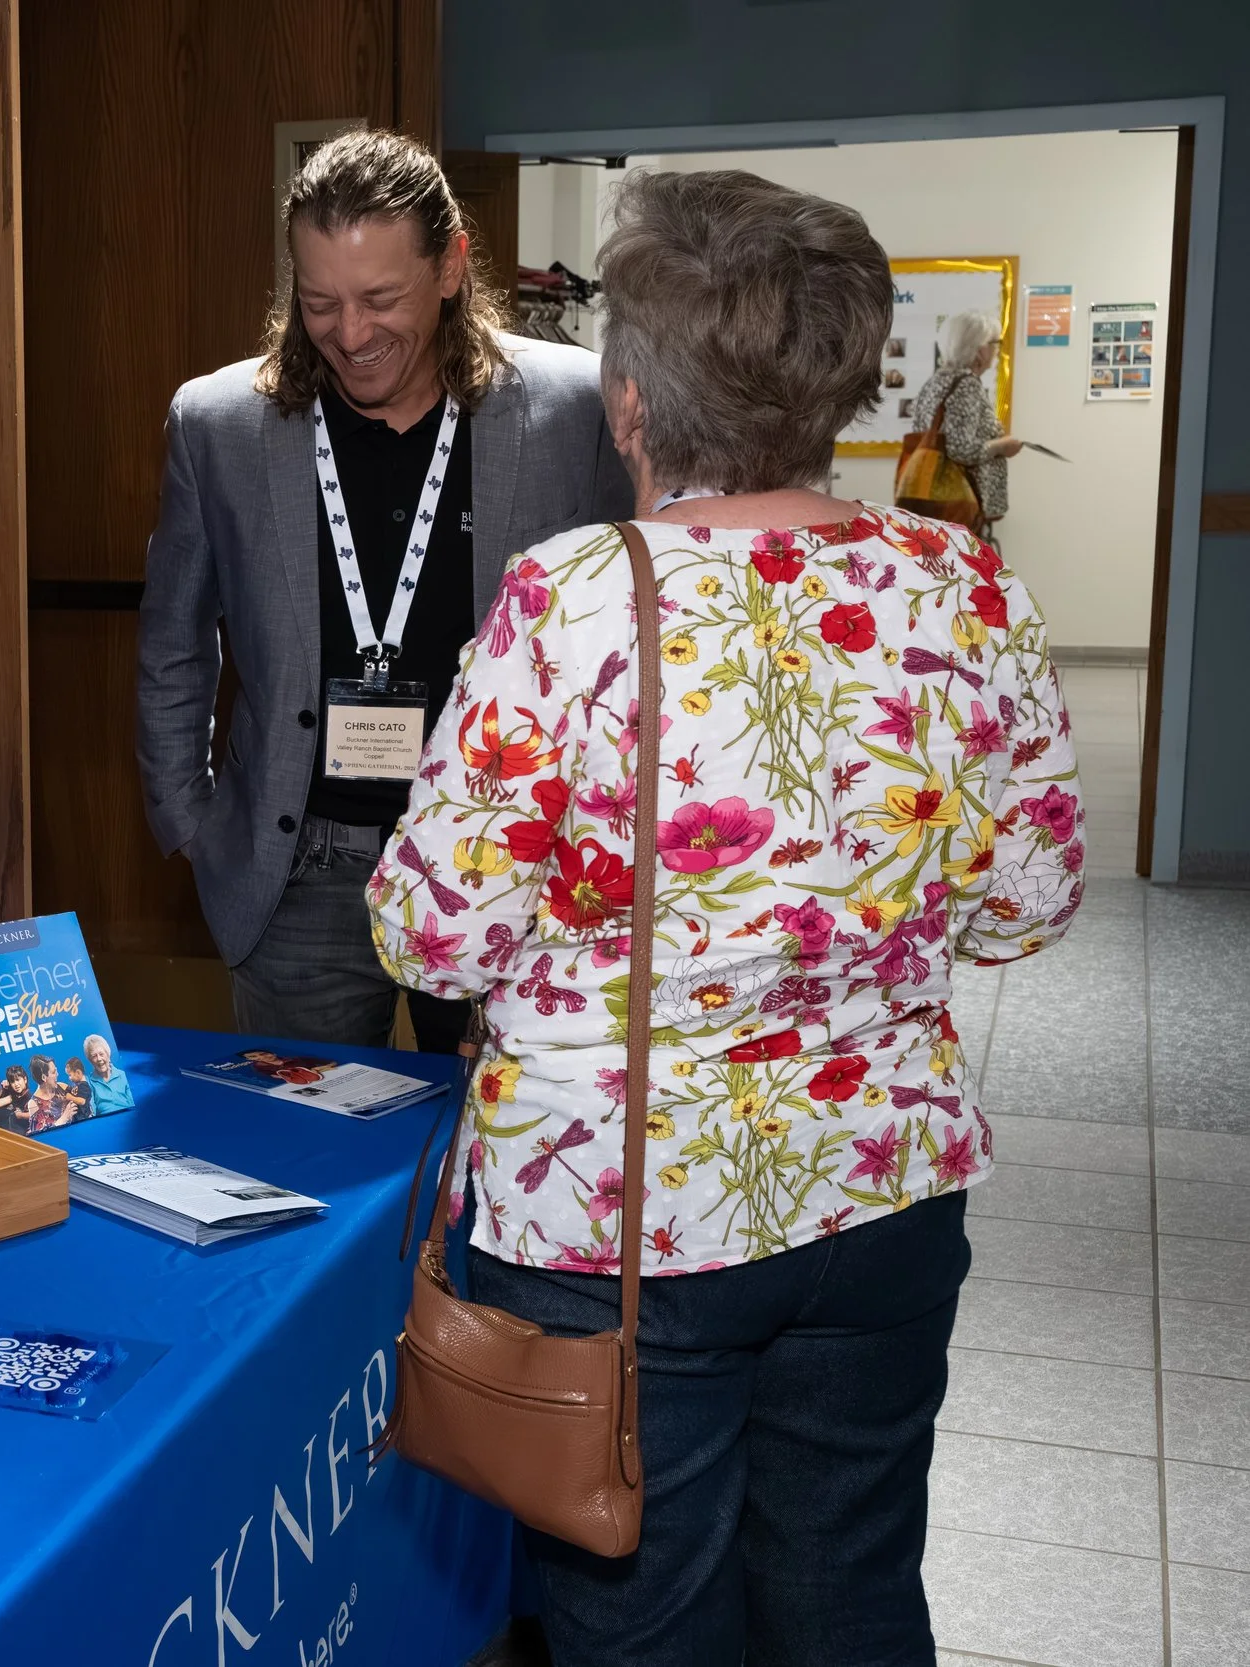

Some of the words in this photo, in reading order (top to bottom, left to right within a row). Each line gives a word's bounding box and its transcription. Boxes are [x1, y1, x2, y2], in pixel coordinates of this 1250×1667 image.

[344, 721, 376, 731] CHRIS
[378, 723, 406, 732] CATO
[17, 992, 82, 1033] Shines
